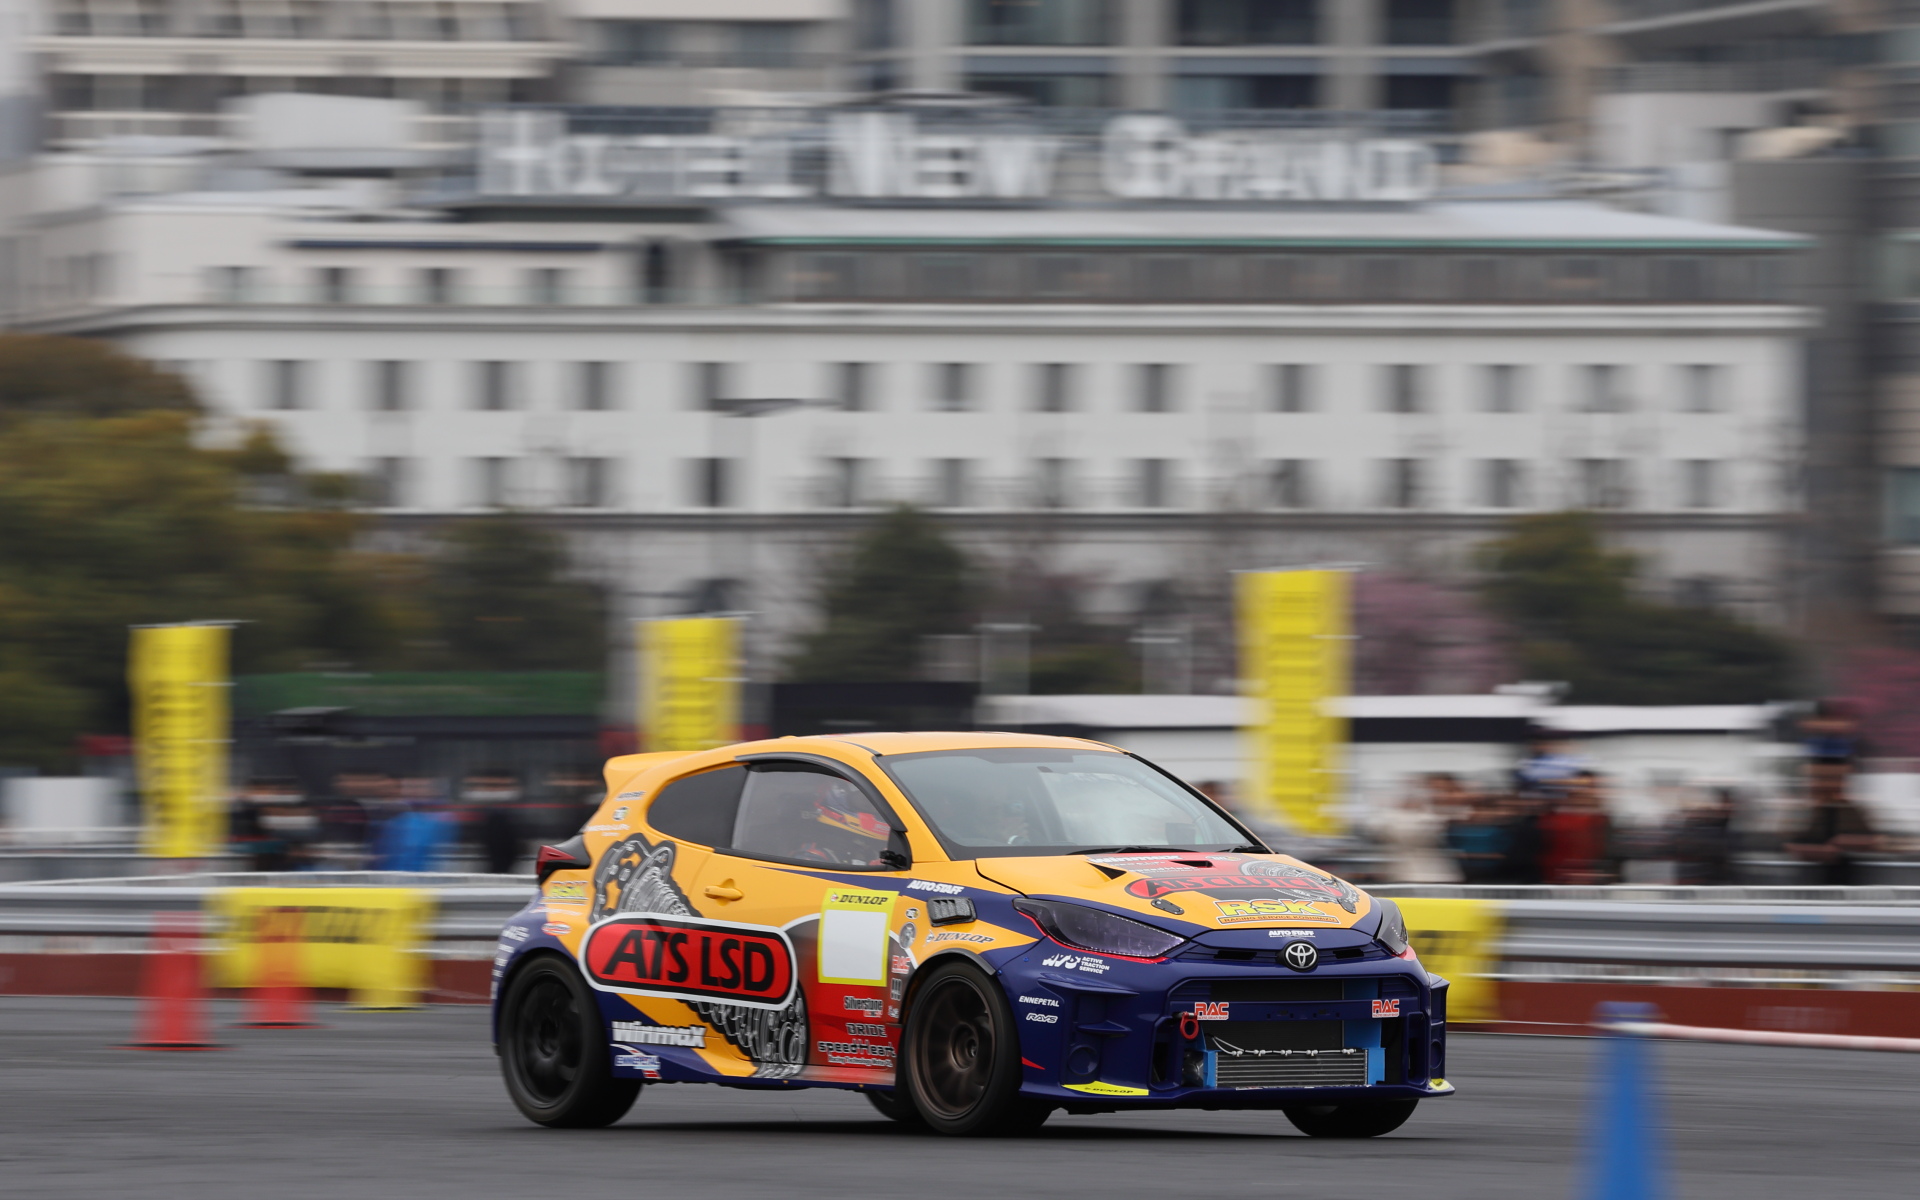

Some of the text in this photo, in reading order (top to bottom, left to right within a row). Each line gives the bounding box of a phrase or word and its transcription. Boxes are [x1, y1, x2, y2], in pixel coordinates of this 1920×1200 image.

[478, 110, 1440, 200] HOTEL NEW GRAND
[907, 880, 965, 895] AUTO STAFF
[1145, 878, 1202, 897] ATS
[839, 895, 888, 905] DUNLOP
[1213, 899, 1326, 916] RSK
[935, 932, 994, 943] DUNLOP
[601, 929, 774, 992] ATS LSD
[1081, 961, 1110, 970] TRACTION
[1082, 956, 1103, 964] ACTIVE
[1079, 966, 1104, 974] SERVICE
[844, 995, 883, 1011] Silverstone
[1019, 995, 1060, 1008] ENNEPETAL
[1372, 999, 1399, 1014] RAC
[1195, 1002, 1229, 1016] RAC
[1026, 1012, 1059, 1024] RAYS
[846, 1023, 888, 1037] BRIDE
